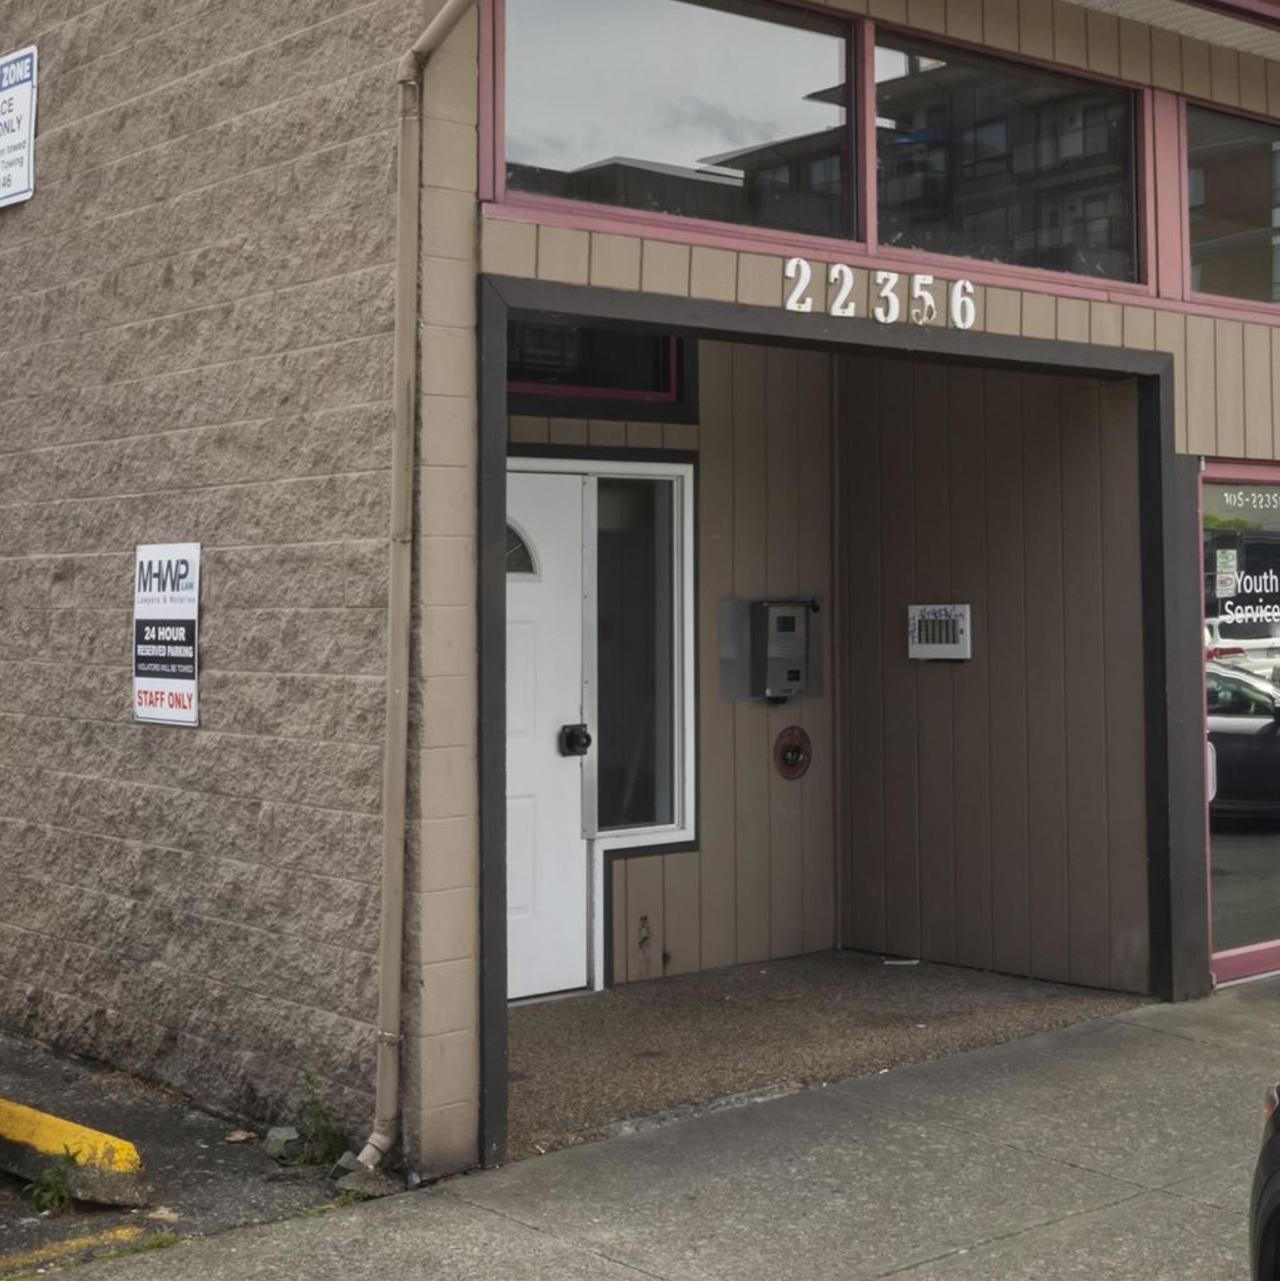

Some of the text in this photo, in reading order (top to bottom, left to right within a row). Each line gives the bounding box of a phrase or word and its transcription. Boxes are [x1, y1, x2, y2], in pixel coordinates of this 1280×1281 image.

[2, 58, 31, 89] ZONE
[785, 257, 976, 329] 22356
[1235, 569, 1279, 593] Youth
[144, 626, 186, 641] 24 HOUR
[137, 644, 194, 658] RESERVED PARKING
[137, 690, 193, 710] STAFF ONLY
